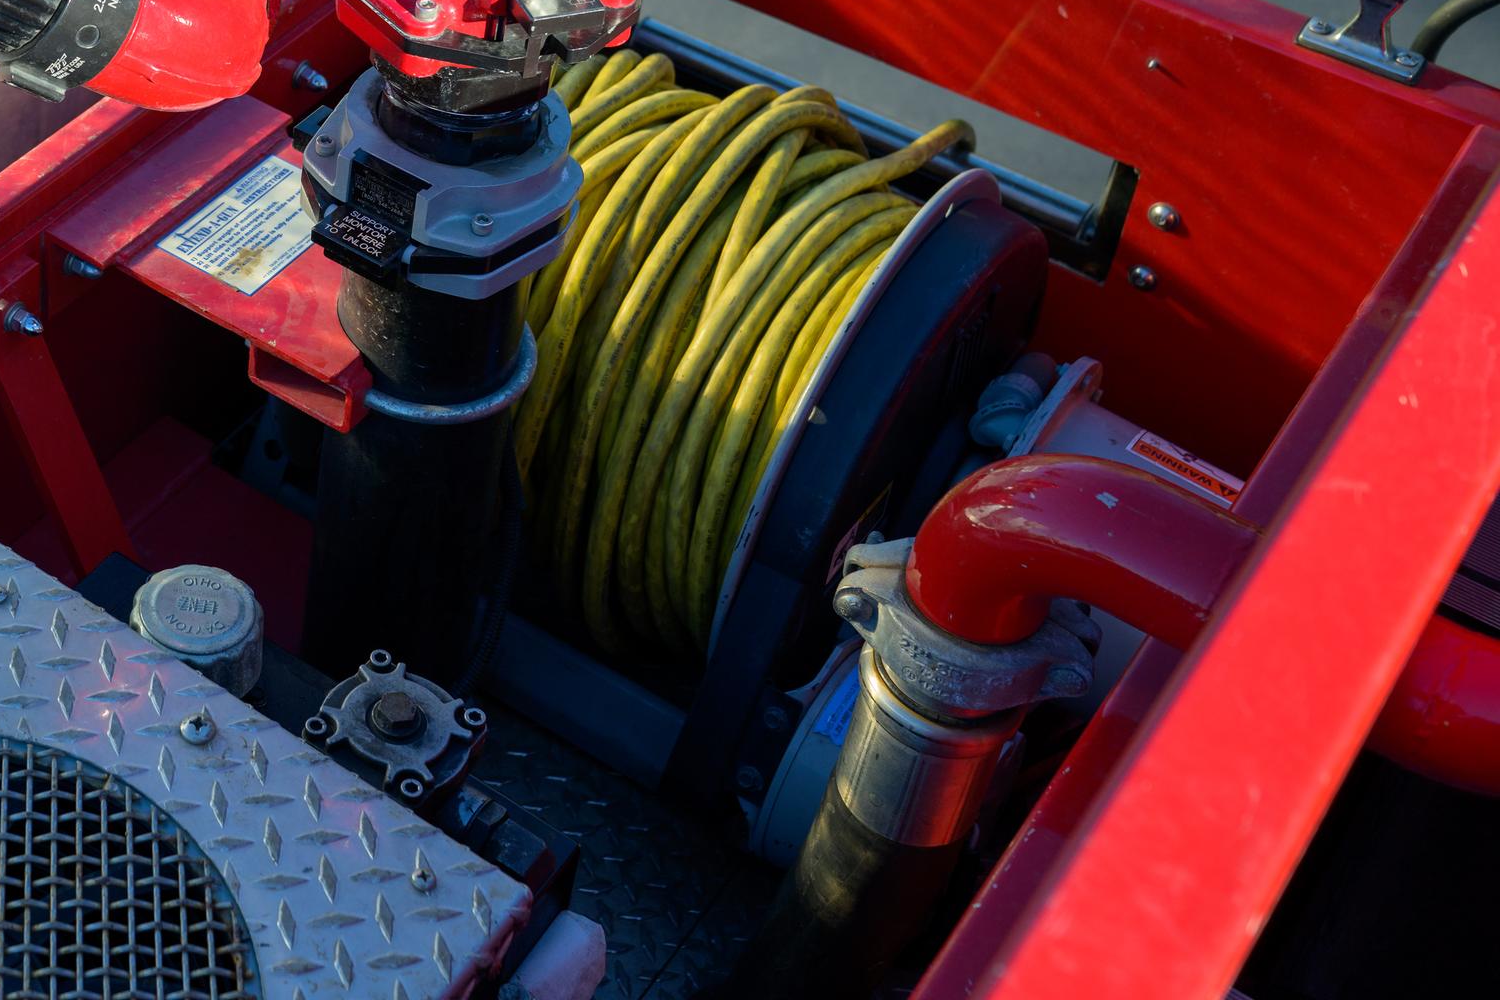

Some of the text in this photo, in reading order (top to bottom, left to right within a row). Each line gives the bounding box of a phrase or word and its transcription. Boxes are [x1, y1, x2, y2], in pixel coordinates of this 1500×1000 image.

[241, 167, 289, 205] INSTRUCTIONS
[333, 220, 385, 250] LIFT HERE
[343, 216, 387, 242] MONITOR,
[350, 210, 397, 236] SUPPORT
[324, 224, 382, 257] TO UNLOCK
[1140, 444, 1212, 486] WARNING
[183, 577, 222, 590] OHIO
[165, 614, 226, 635] DAYTON
